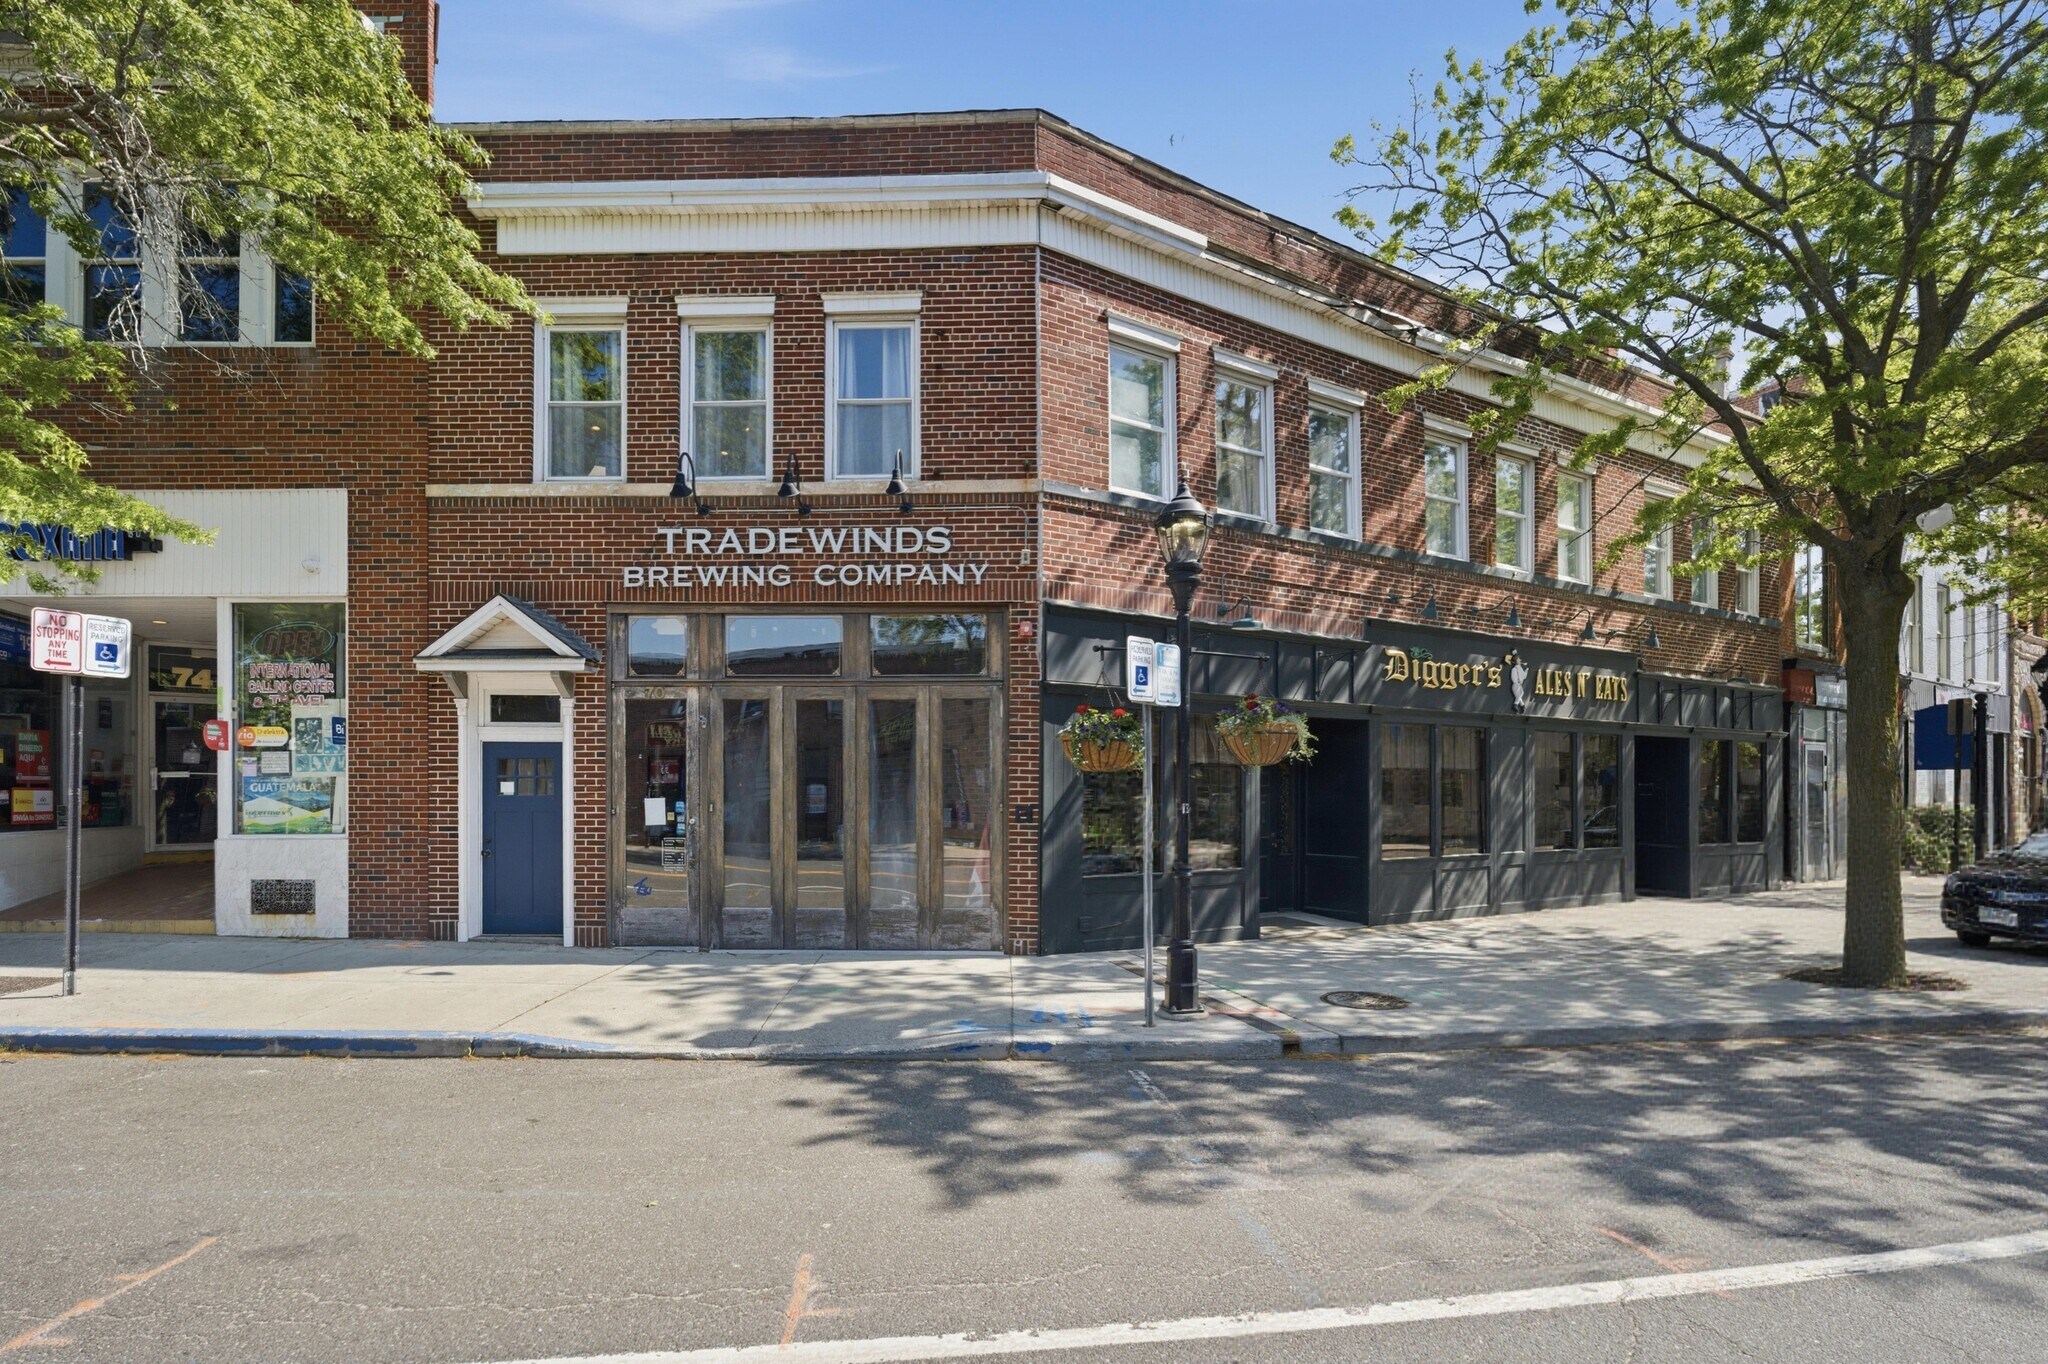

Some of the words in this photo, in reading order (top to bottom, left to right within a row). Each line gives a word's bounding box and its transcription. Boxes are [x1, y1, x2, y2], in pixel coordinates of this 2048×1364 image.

[657, 526, 951, 554] TRADEWINDS
[623, 565, 791, 587] BREWING
[814, 564, 989, 586] COMPANY
[48, 614, 67, 627] NO
[36, 626, 79, 641] STOPPING
[89, 623, 125, 635] RESERVED
[48, 640, 67, 649] ANY
[90, 633, 123, 643] PARKING
[48, 649, 67, 658] TIME
[171, 666, 213, 690] 74
[249, 662, 334, 679] INTERNATIONAL
[248, 679, 292, 694] CALLING
[293, 679, 335, 694] CENTER
[1534, 668, 1572, 697] ALES
[1595, 674, 1628, 702] EATS
[645, 687, 665, 699] 70
